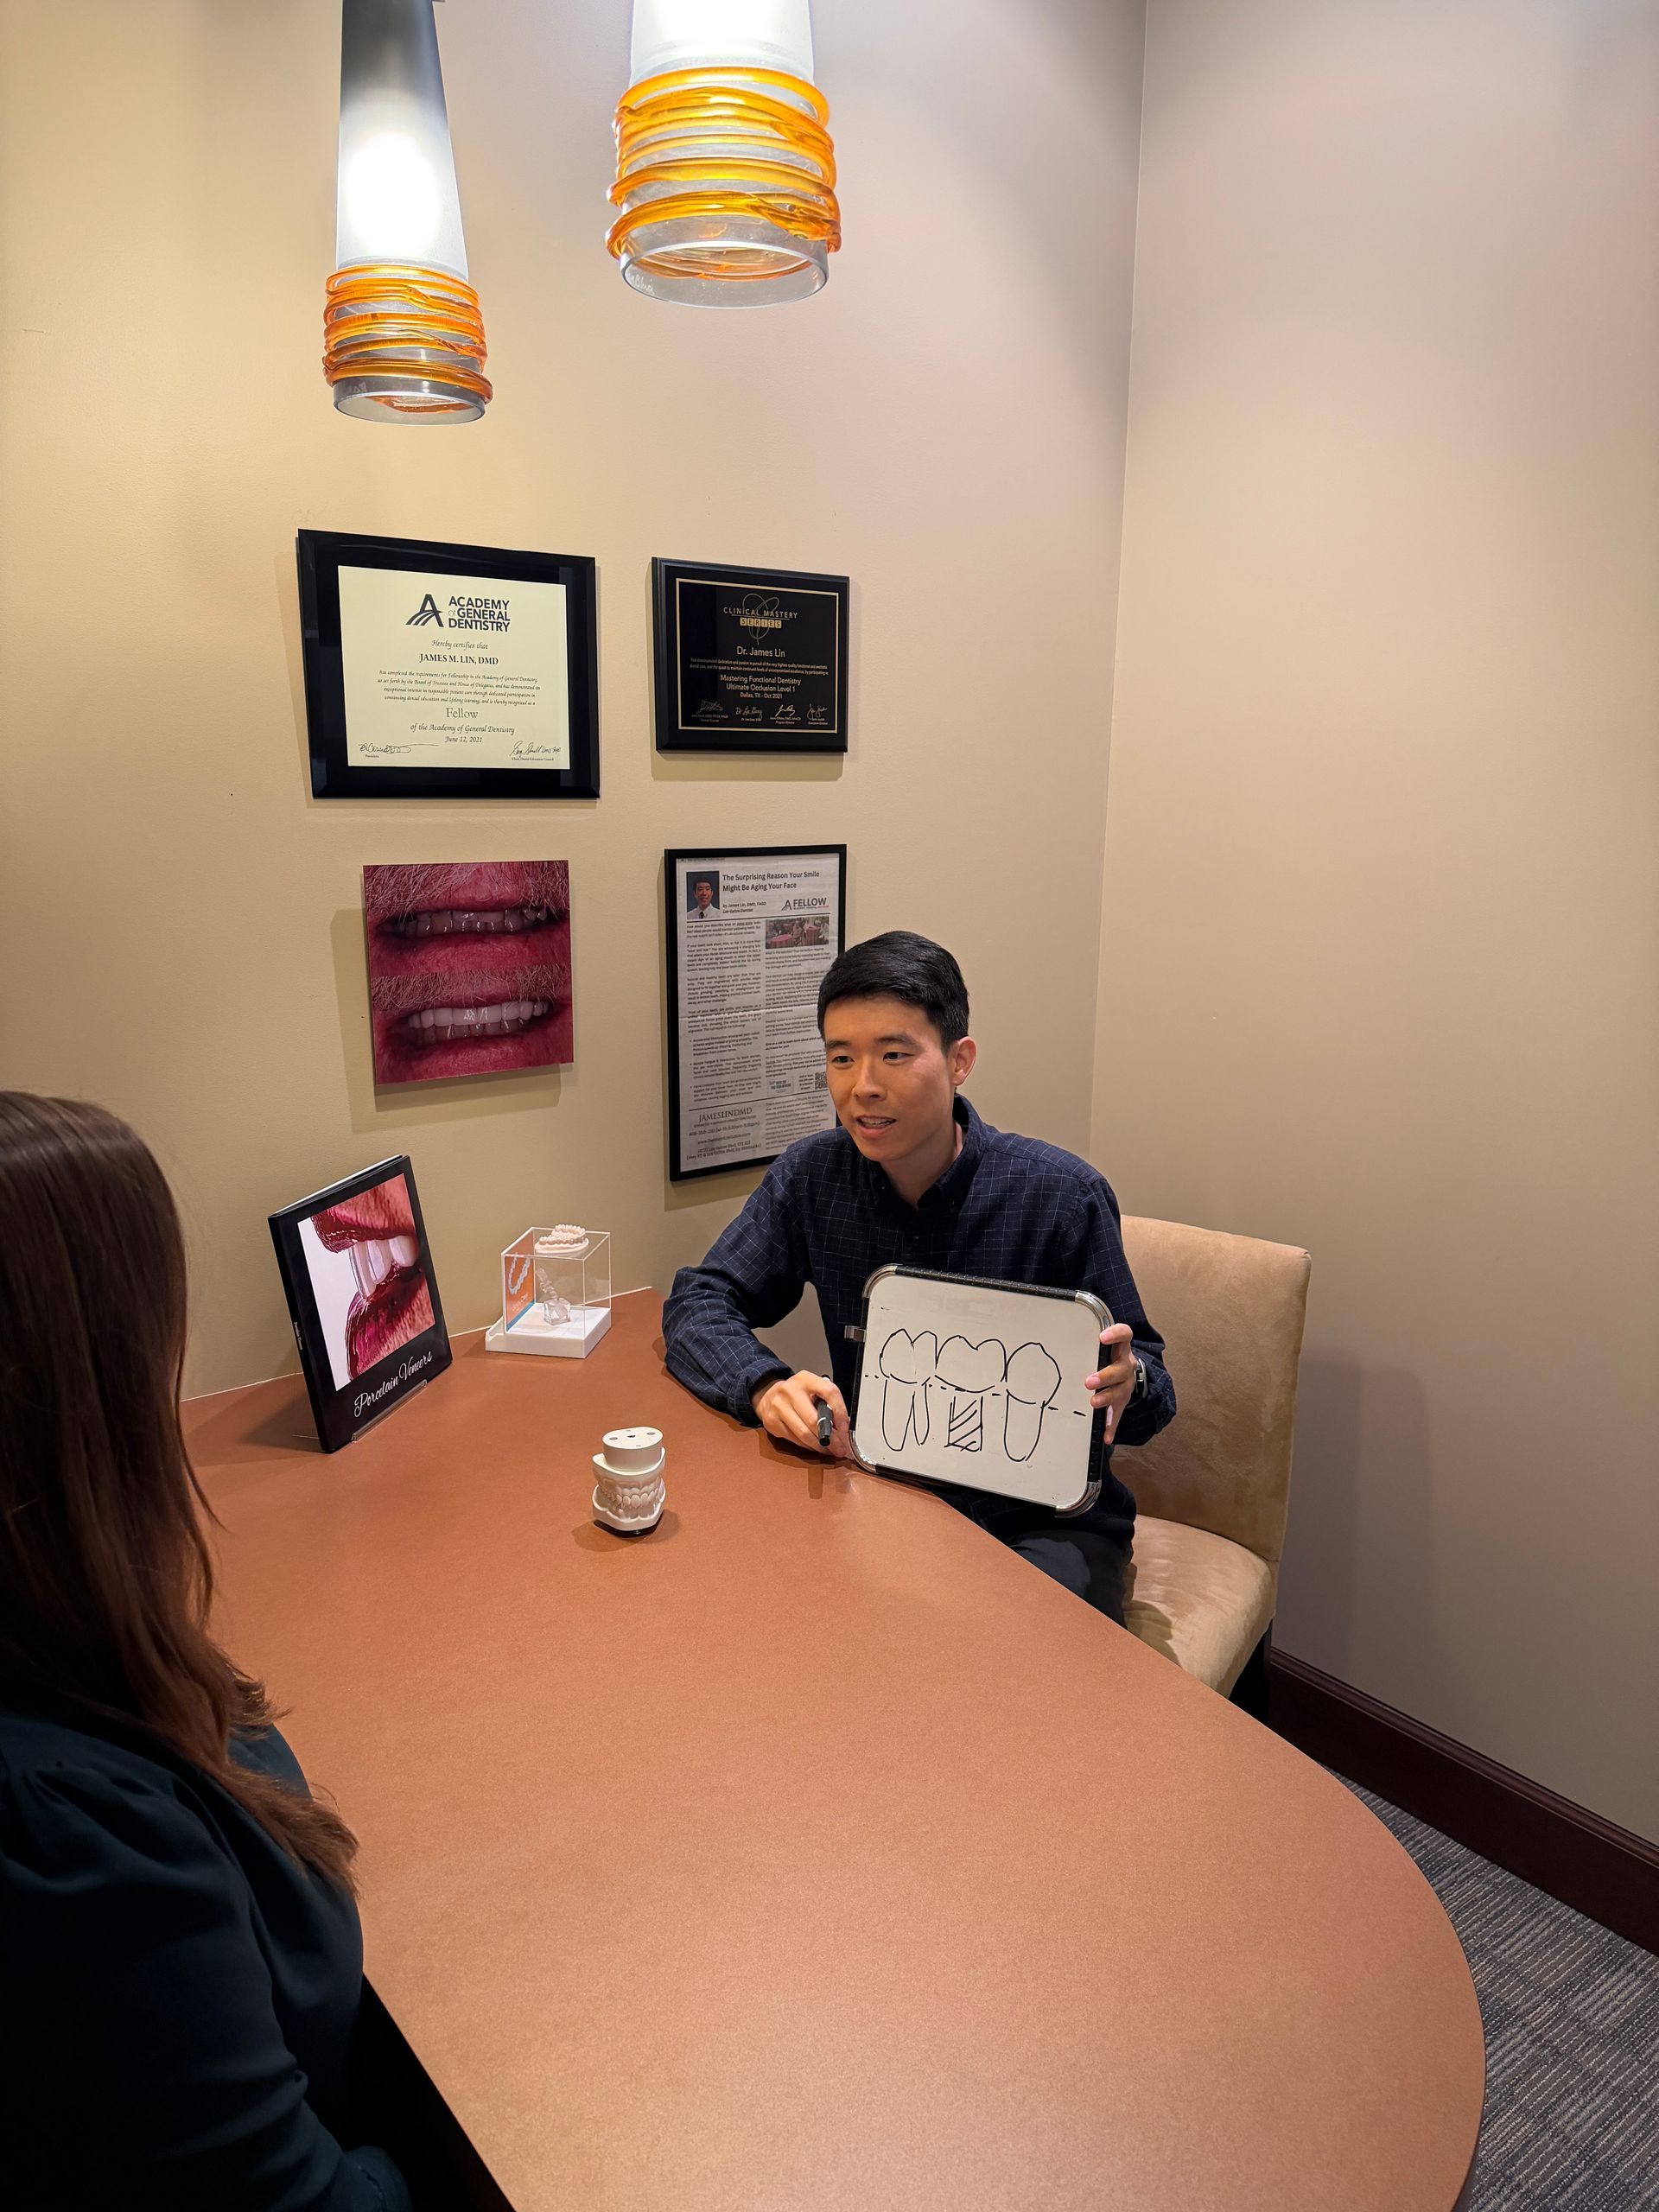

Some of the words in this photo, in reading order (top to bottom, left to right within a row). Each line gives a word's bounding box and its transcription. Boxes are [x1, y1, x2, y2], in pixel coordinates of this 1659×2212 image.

[448, 595, 510, 610] ACADEMY
[448, 607, 456, 617] of
[457, 607, 511, 621] GENERAL
[723, 607, 760, 616] CLINICAL
[764, 610, 798, 620] MASTERY
[448, 618, 511, 632] DENTISTRY
[741, 618, 781, 628] SERIES
[431, 639, 452, 649] Hereby
[453, 641, 475, 651] certifies
[736, 646, 747, 656] Dr.
[750, 647, 772, 657] James
[774, 648, 785, 658] Lin
[419, 653, 448, 663] JAMES
[460, 656, 477, 665] LIN,
[478, 657, 499, 665] DMD
[721, 674, 748, 684] Mastering
[778, 677, 802, 686] Dentistry
[446, 708, 479, 719] Fellow
[410, 723, 416, 732] of
[430, 724, 456, 734] Academy
[457, 725, 464, 734] of
[487, 726, 515, 735] Dentistry
[735, 873, 766, 882] Surprising
[722, 884, 741, 893] Might
[750, 883, 767, 892] Aging
[793, 897, 828, 906] FELLOW
[698, 1107, 753, 1123] JAMESLINDMD
[354, 1376, 399, 1417] Porcelain
[399, 1351, 433, 1381] Veneers
